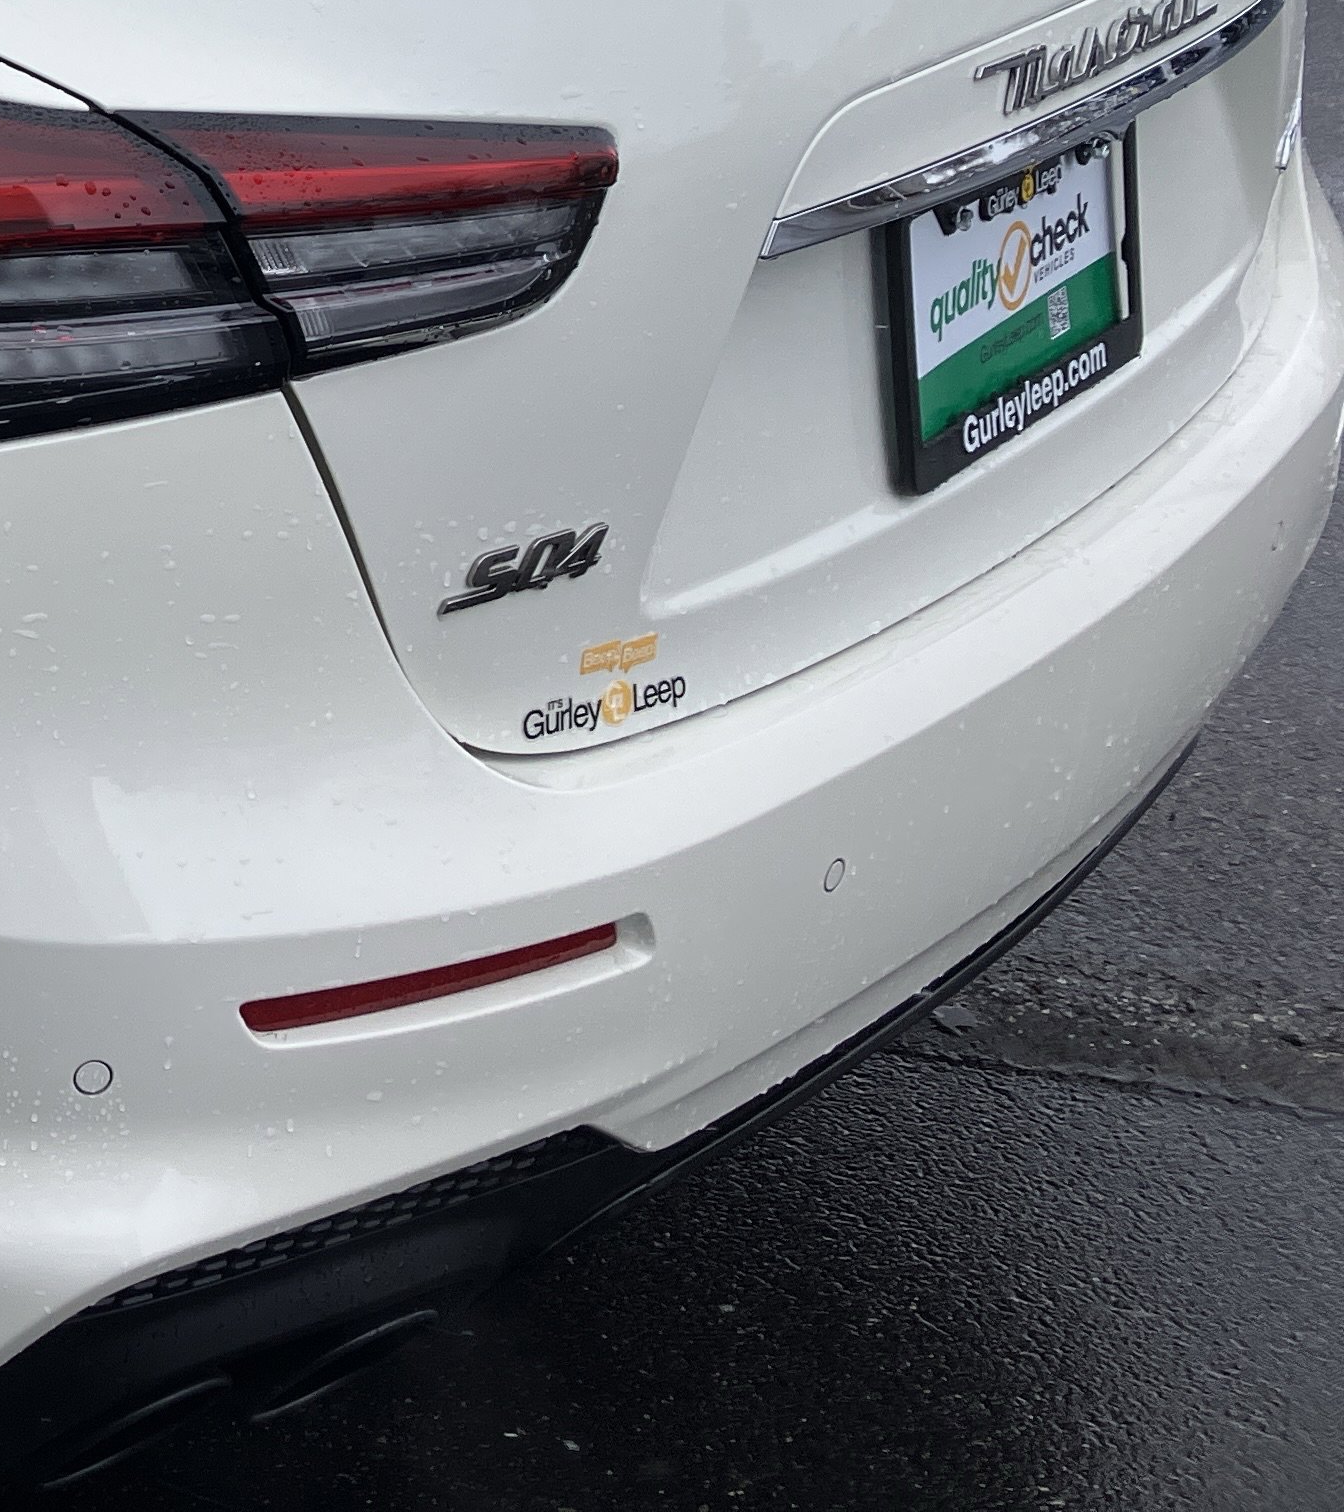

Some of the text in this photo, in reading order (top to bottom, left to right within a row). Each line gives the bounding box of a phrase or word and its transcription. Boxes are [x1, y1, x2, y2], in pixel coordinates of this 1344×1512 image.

[930, 192, 1090, 343] quality check
[1033, 247, 1075, 284] VEHICLES
[963, 342, 1108, 453] Gurleyleep.com
[523, 698, 602, 739] Gurley
[632, 676, 686, 713] Leep
